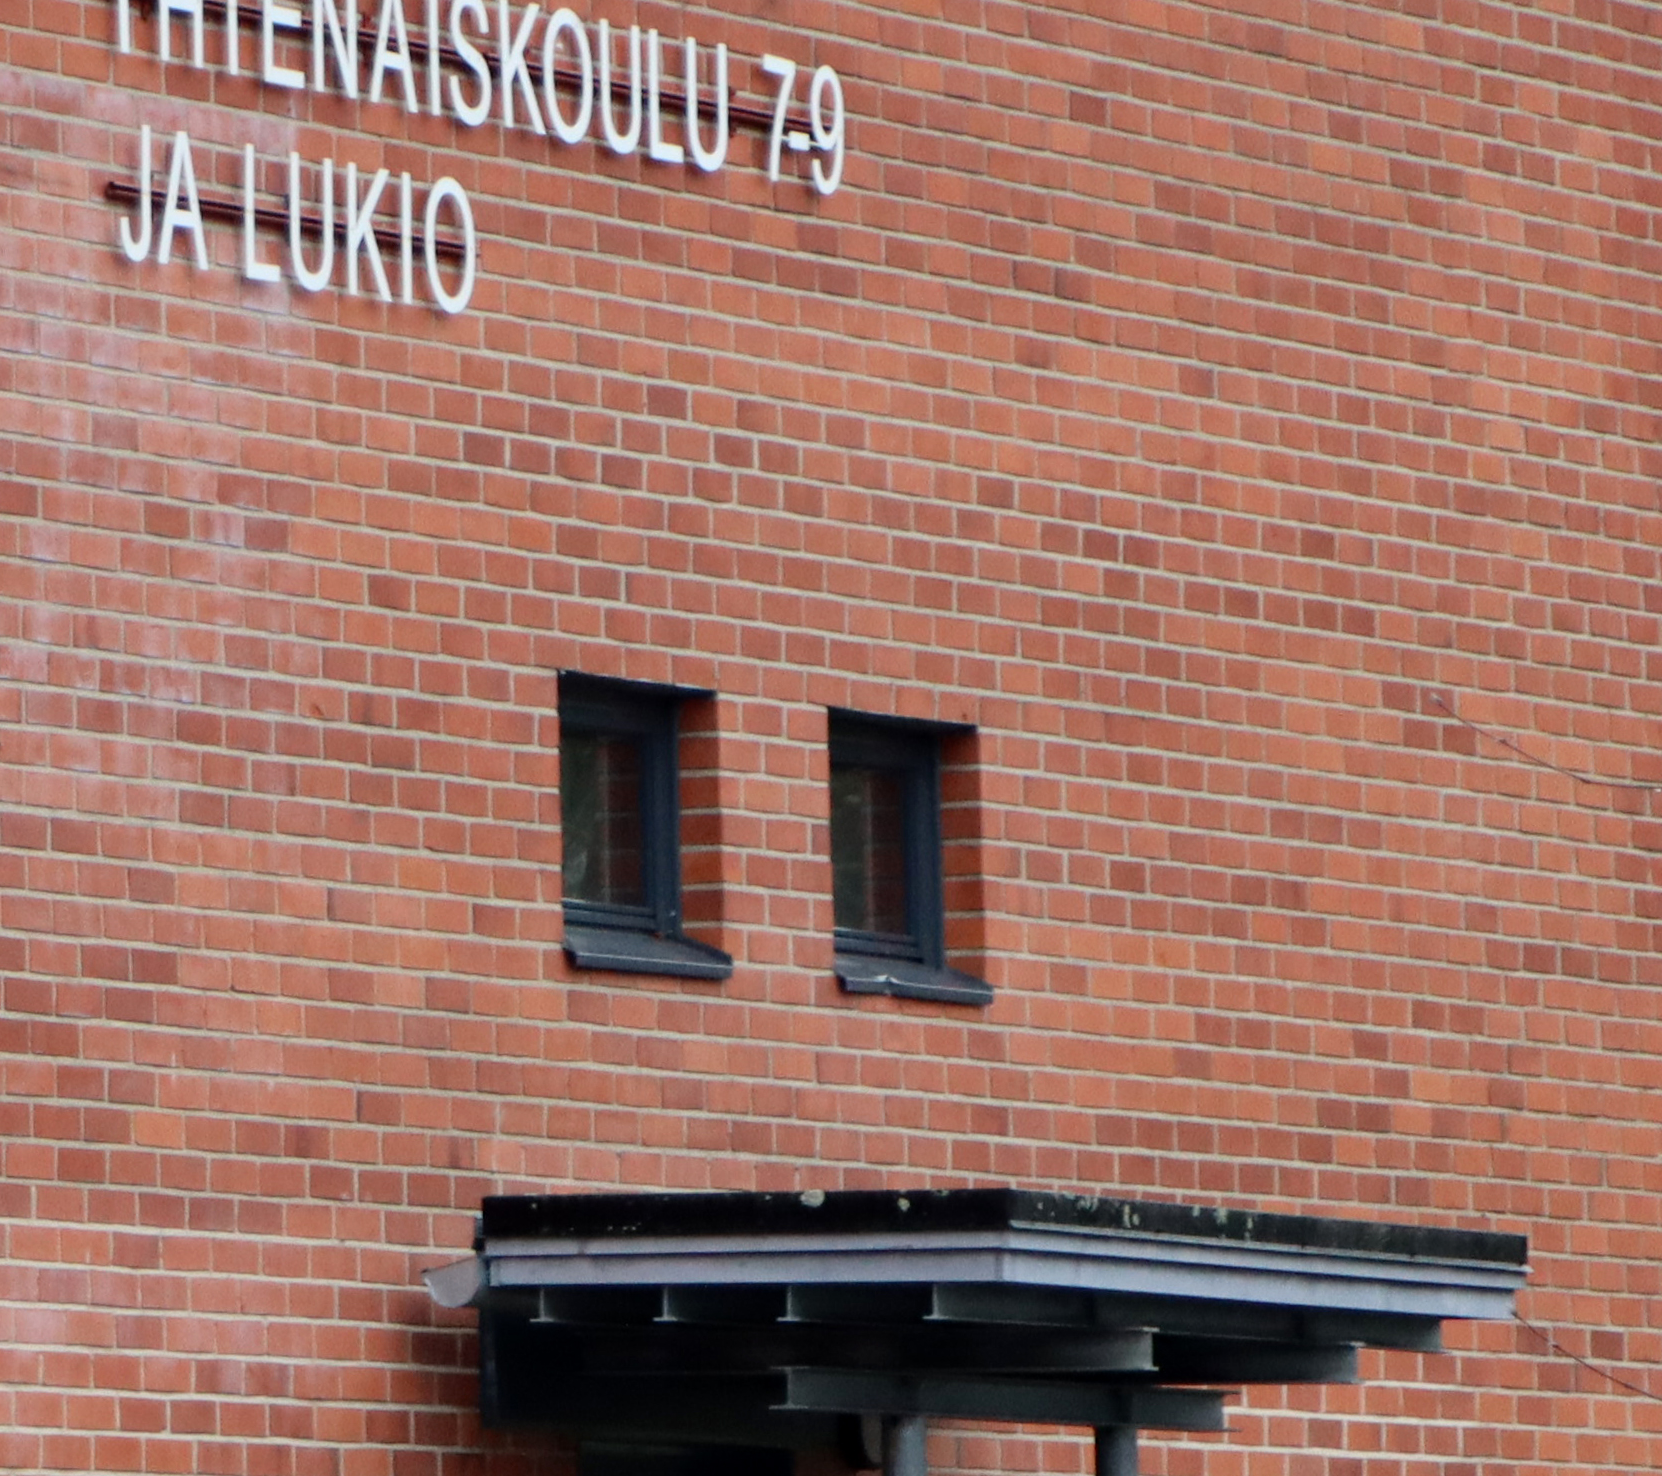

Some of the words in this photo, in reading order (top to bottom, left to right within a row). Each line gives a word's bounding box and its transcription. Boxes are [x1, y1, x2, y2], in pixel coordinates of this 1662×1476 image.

[762, 53, 845, 196] 7-9
[119, 125, 209, 271] JA
[244, 143, 477, 315] LUKIO
